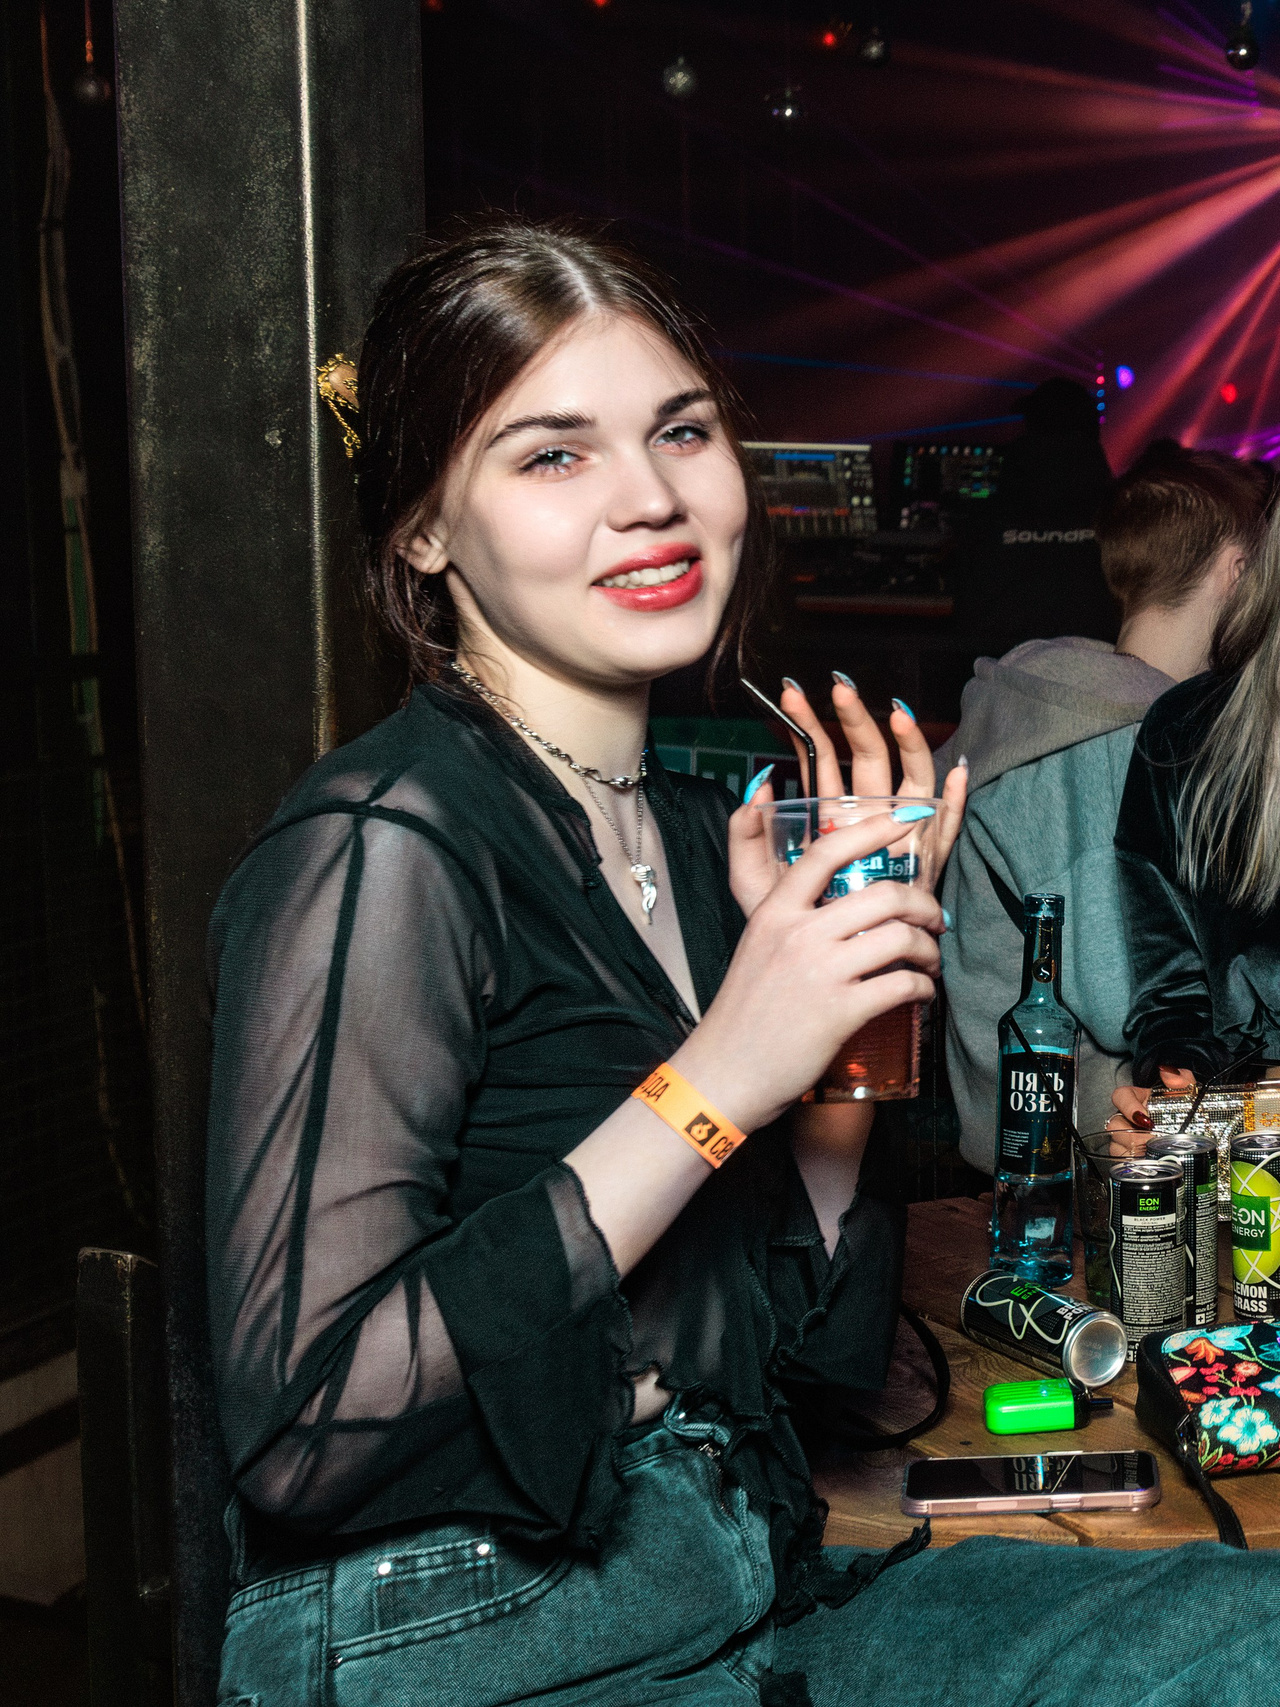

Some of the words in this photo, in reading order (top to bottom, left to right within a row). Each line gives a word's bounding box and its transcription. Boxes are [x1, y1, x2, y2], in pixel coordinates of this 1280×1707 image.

[641, 1072, 670, 1102] ДА
[1139, 1197, 1160, 1207] EON
[1232, 1205, 1266, 1226] EON
[1232, 1225, 1266, 1238] ENERGY
[1233, 1280, 1268, 1299] LEMON
[1233, 1295, 1268, 1313] GRASS
